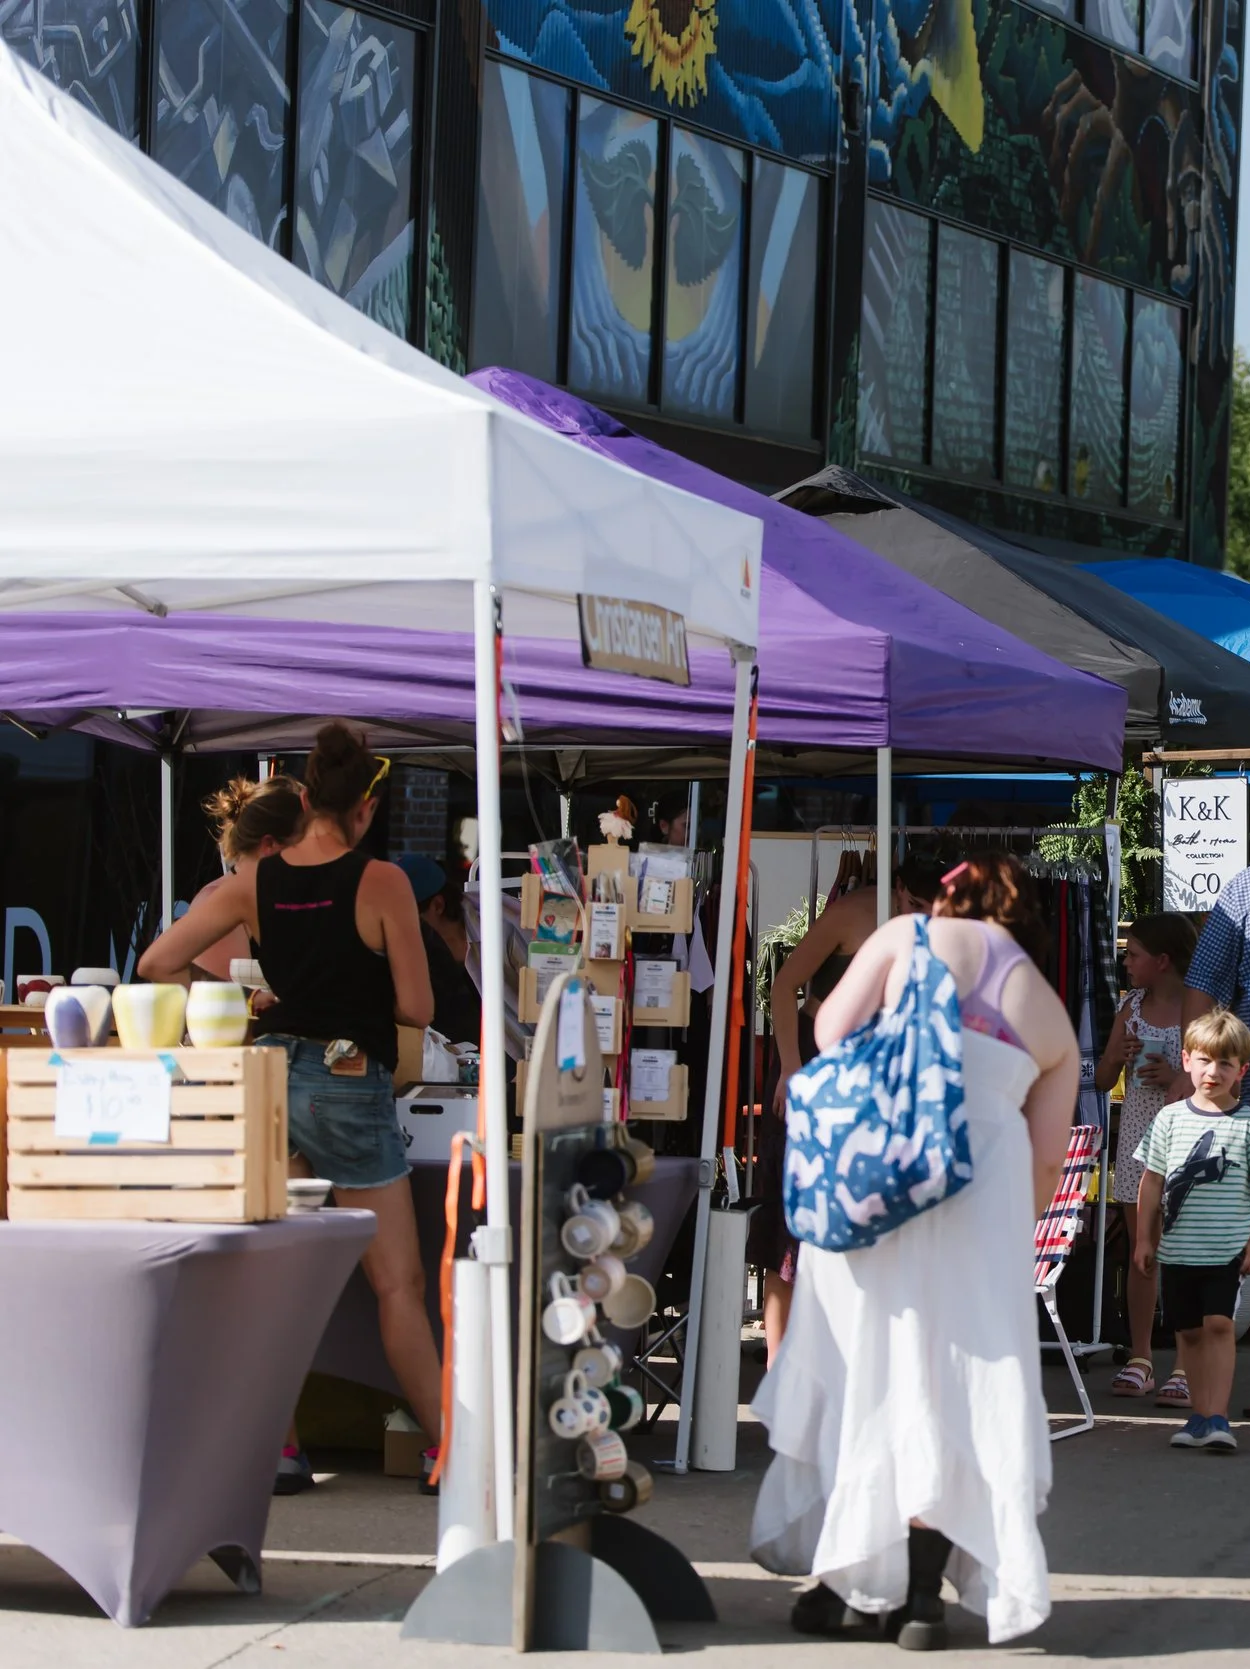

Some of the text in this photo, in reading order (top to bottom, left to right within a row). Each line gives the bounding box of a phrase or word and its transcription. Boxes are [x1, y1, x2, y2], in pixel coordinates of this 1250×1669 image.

[1179, 795, 1232, 821] K&K
[1172, 829, 1201, 846] Bath
[1190, 872, 1221, 894] CO
